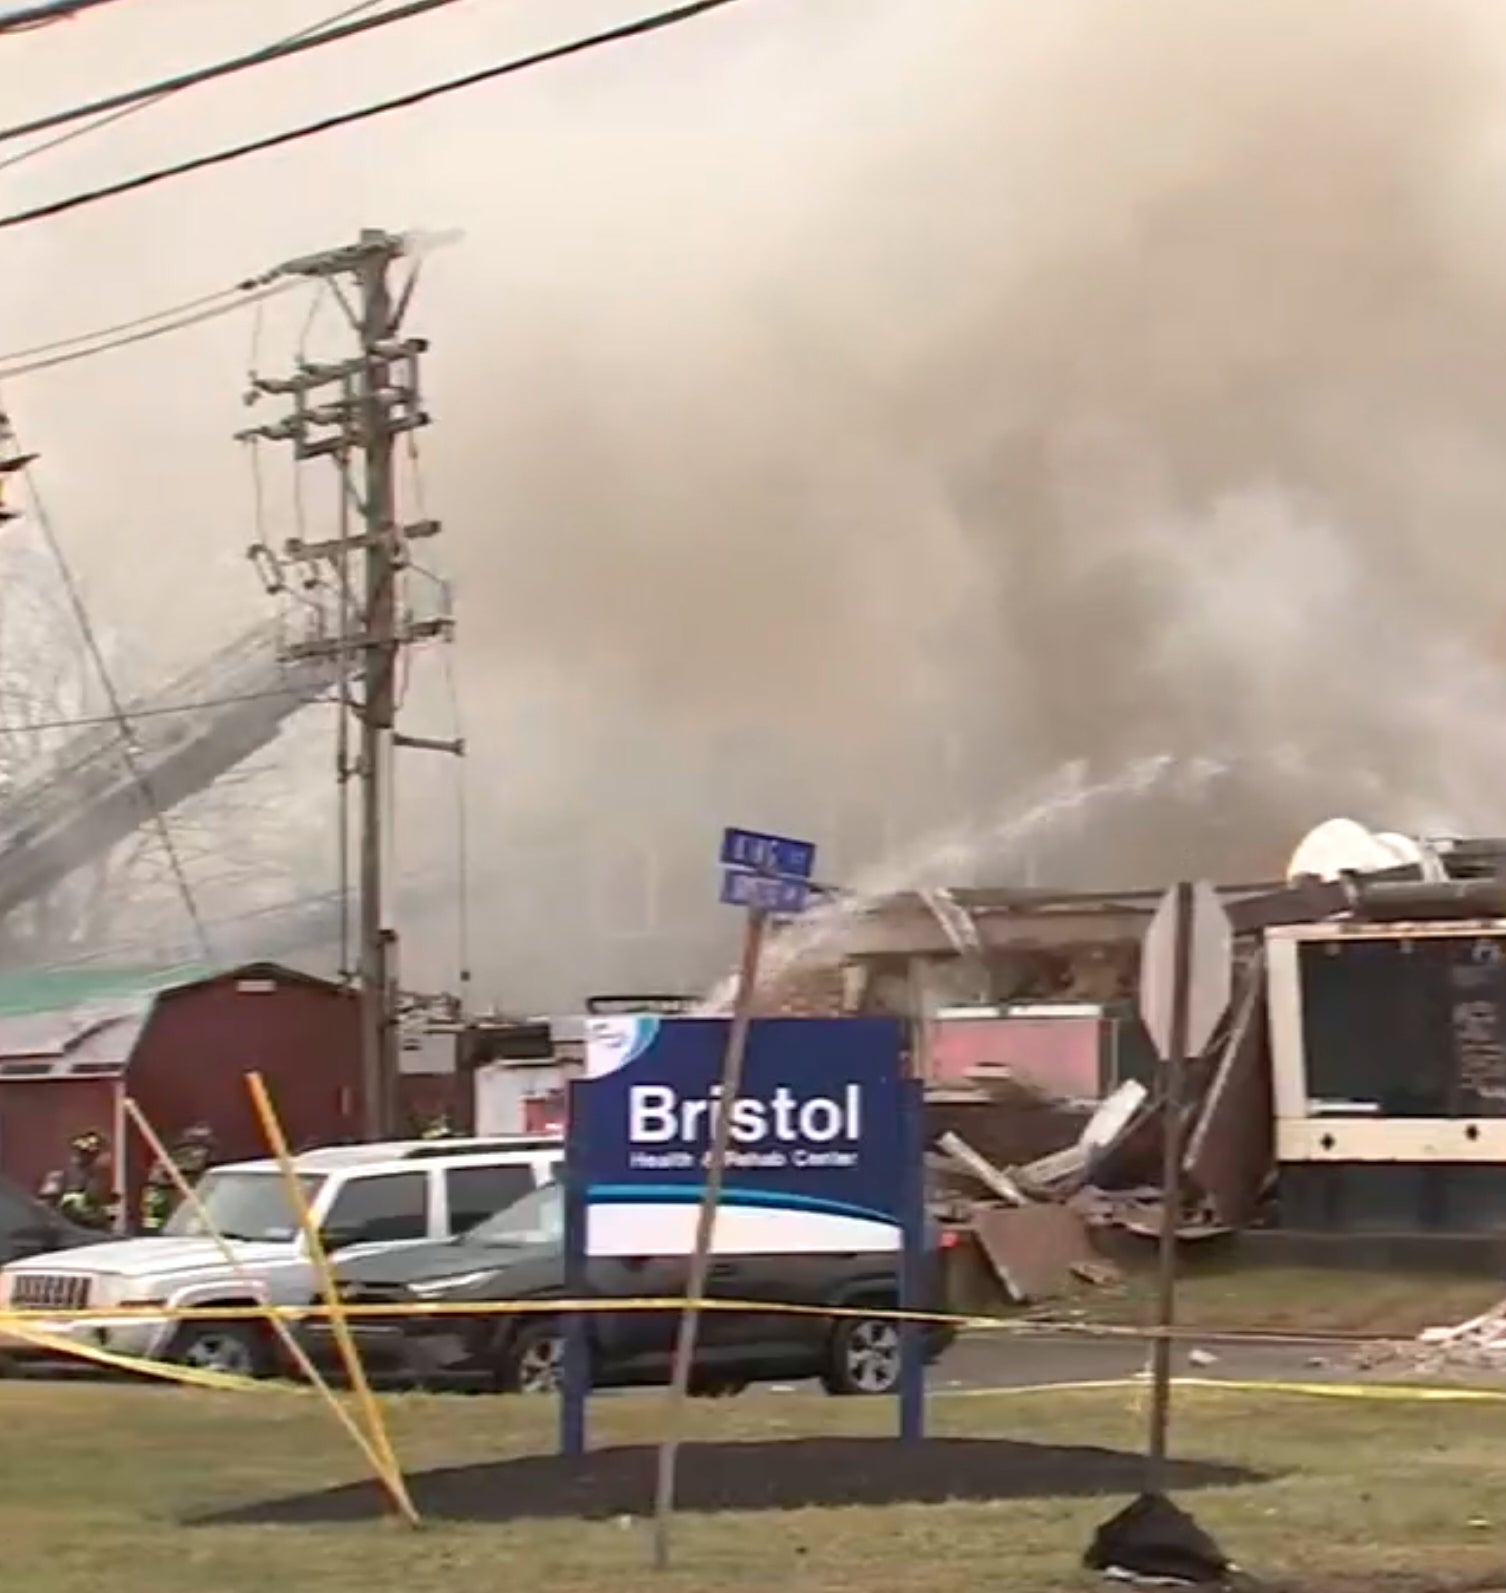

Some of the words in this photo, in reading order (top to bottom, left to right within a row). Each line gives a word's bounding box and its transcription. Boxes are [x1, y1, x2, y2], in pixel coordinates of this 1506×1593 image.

[629, 1084, 860, 1142] Bristol
[629, 1151, 694, 1168] Health
[791, 1149, 859, 1168] Center
